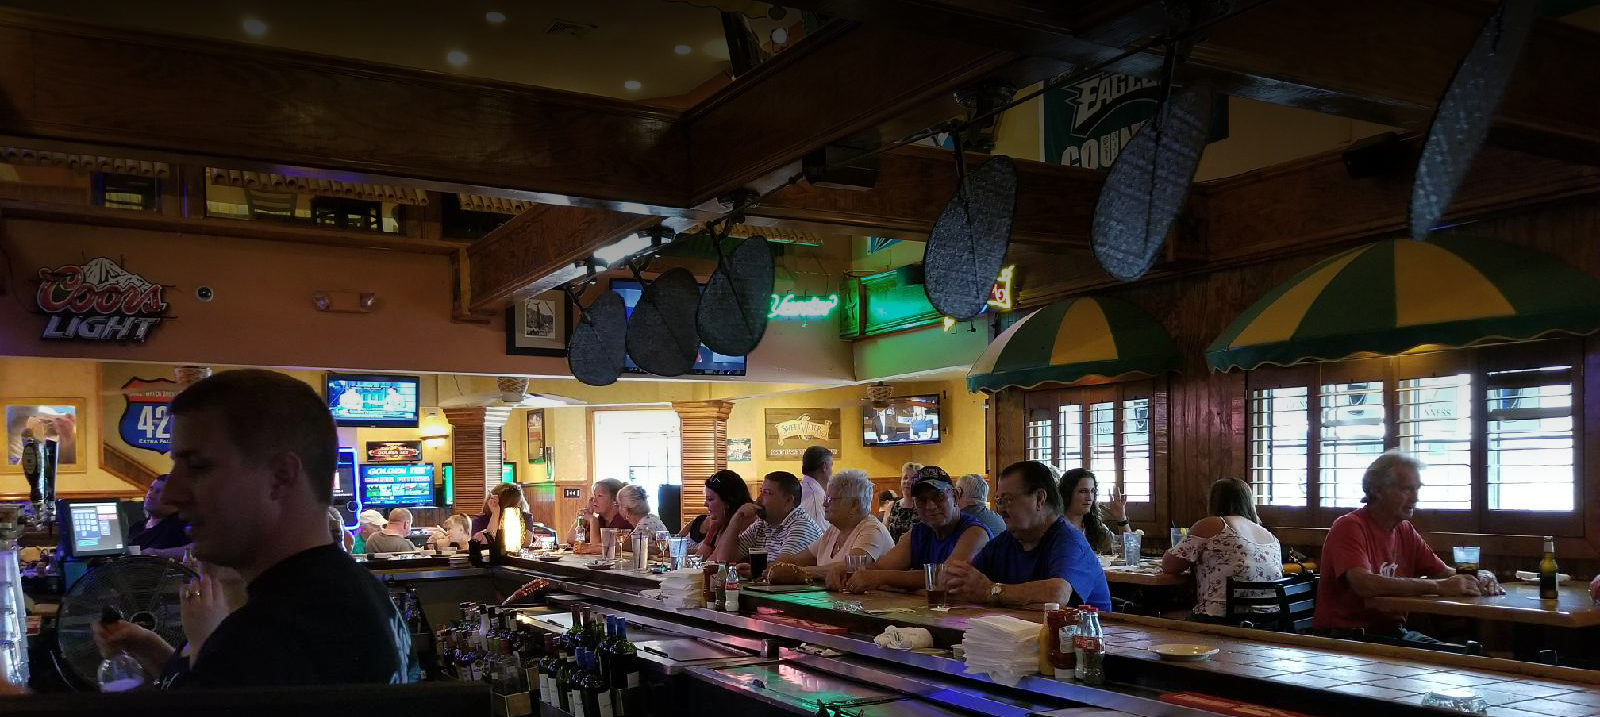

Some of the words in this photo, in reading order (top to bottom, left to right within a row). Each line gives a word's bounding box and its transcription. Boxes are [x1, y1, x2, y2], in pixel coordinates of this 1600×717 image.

[1074, 74, 1161, 128] EAGL
[1061, 120, 1149, 169] COUN
[37, 265, 164, 315] Coors
[42, 315, 160, 341] LIGHT
